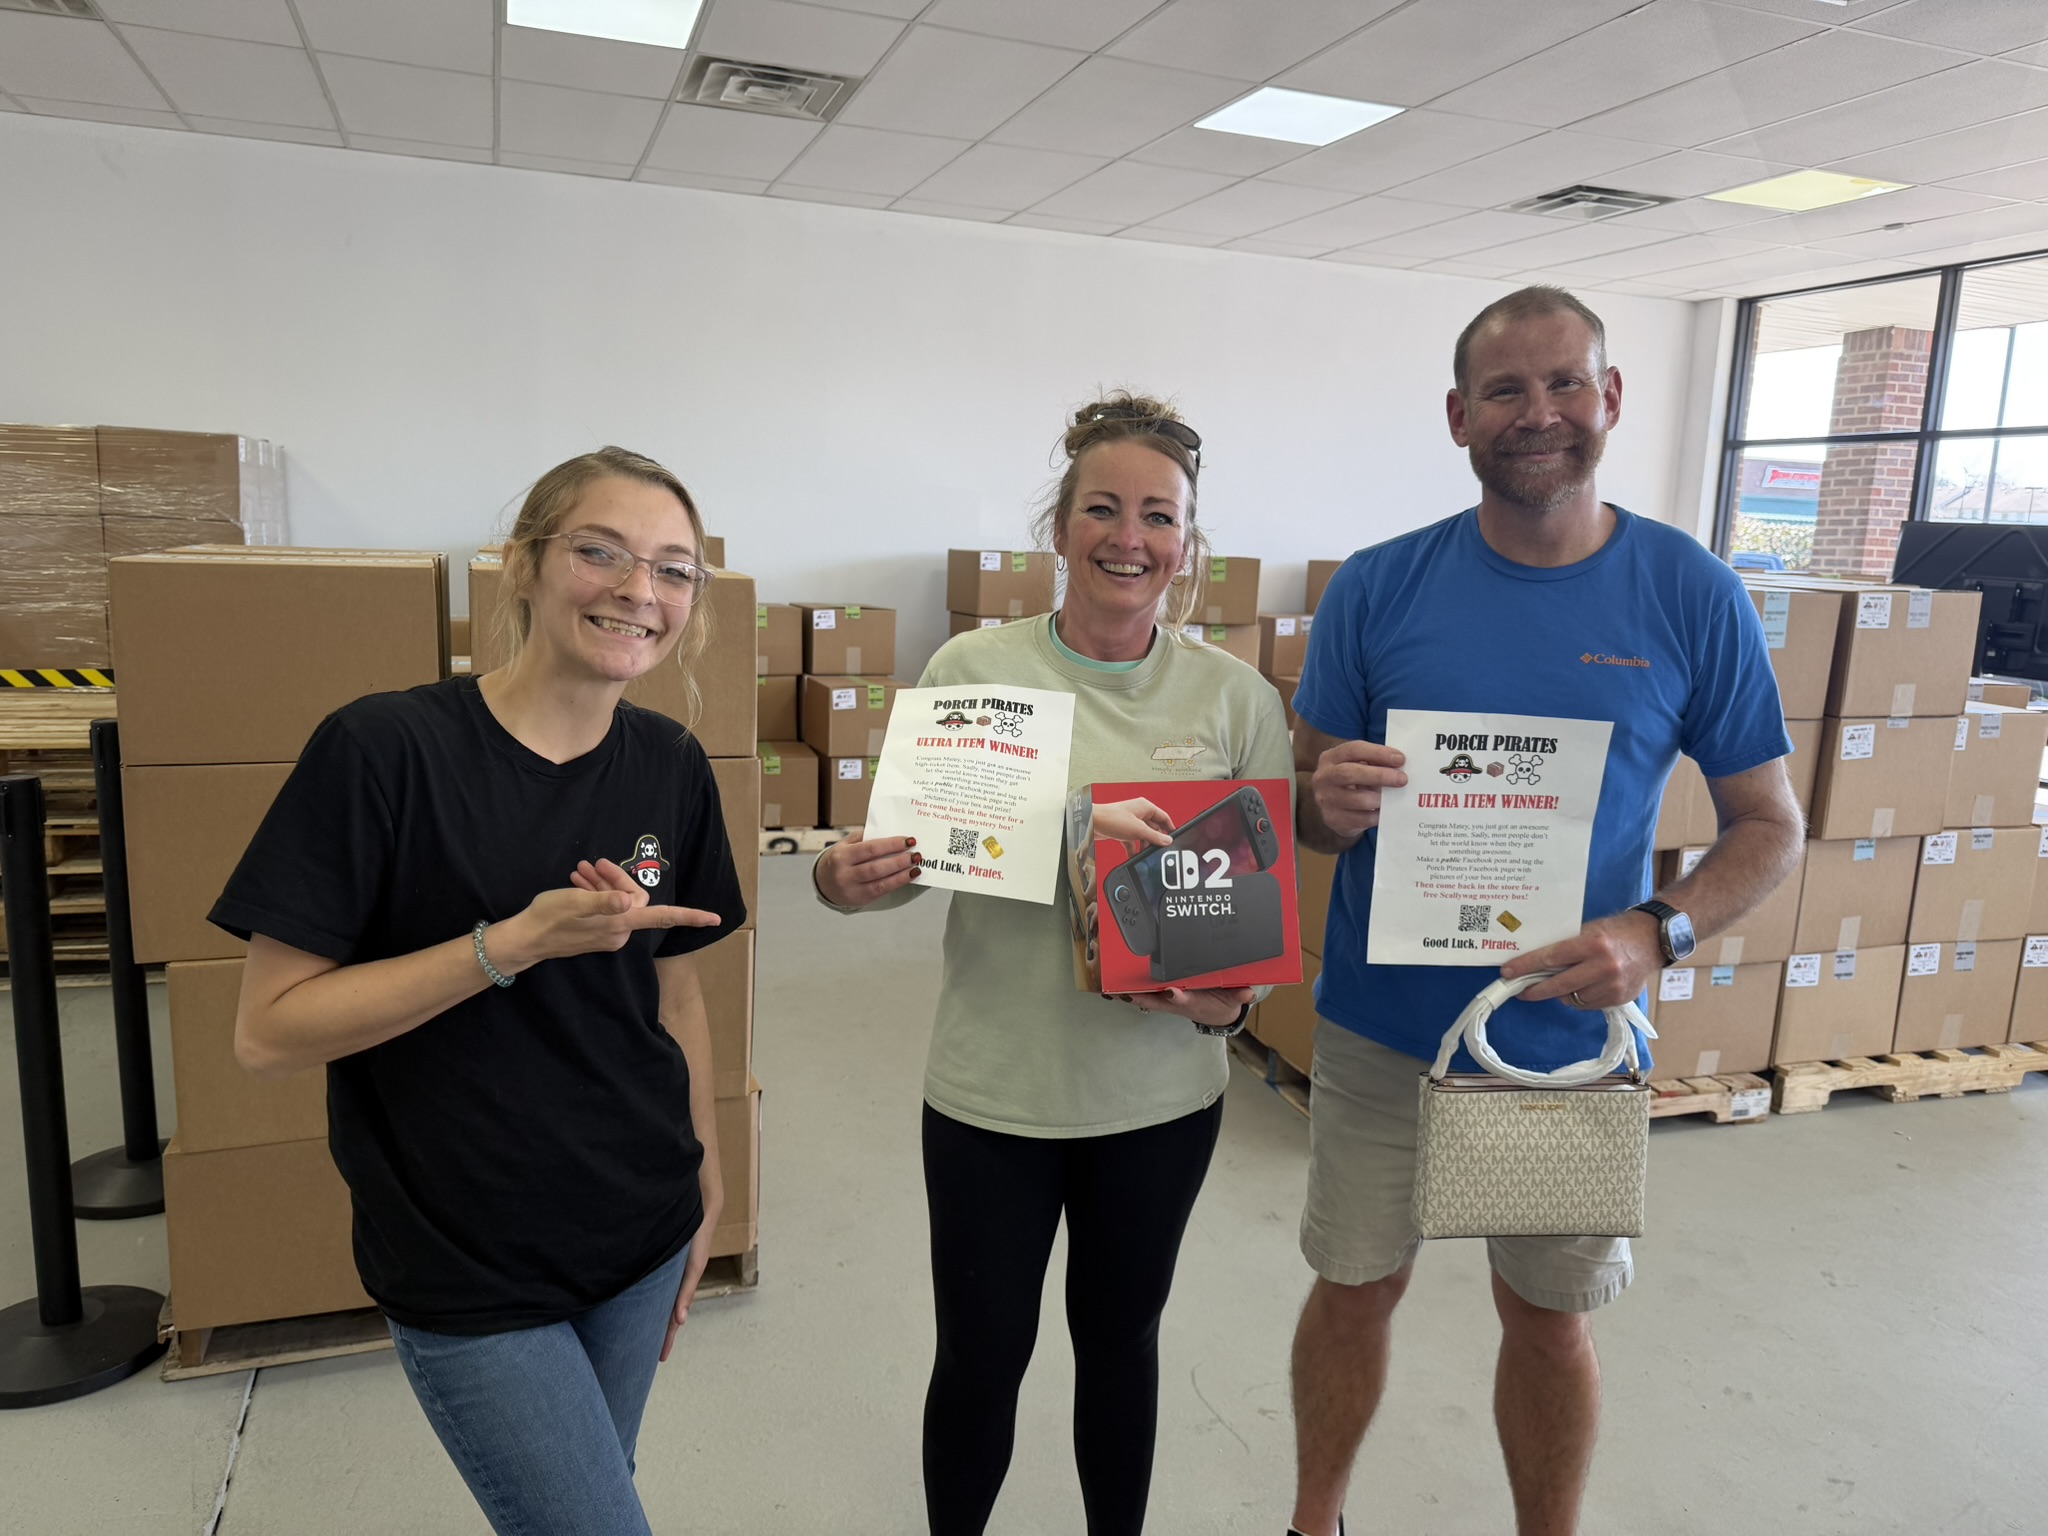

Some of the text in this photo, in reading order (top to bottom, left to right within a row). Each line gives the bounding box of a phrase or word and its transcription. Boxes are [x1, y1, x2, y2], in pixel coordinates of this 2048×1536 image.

[1594, 654, 1650, 668] Columbia
[933, 698, 1034, 716] PORCH PIRATES
[916, 738, 1038, 760] ULTRA ITEM WINNER!
[1434, 734, 1558, 754] PORCH PIRATES
[1006, 766, 1032, 775] awesome
[942, 776, 1000, 790] something awesome.
[955, 783, 982, 794] Facebook
[940, 788, 960, 796] Pirates
[960, 792, 988, 802] Facebook
[1418, 793, 1559, 810] ULTRA ITEM WINNER!
[910, 798, 928, 807] Then
[929, 803, 948, 811] come
[949, 806, 966, 814] back
[988, 813, 1006, 821] store
[916, 809, 1014, 831] free Scallywag mystery box!
[1508, 840, 1522, 848] they
[917, 858, 1004, 880] ood Luck, Pirates.
[1202, 848, 1233, 888] 2
[1506, 874, 1526, 882] prize!
[1166, 894, 1232, 903] NINTENDO
[1440, 892, 1478, 900] Scallywag
[1166, 904, 1232, 918] SWITCH
[1423, 937, 1520, 950] Good Luck, Pirates.
